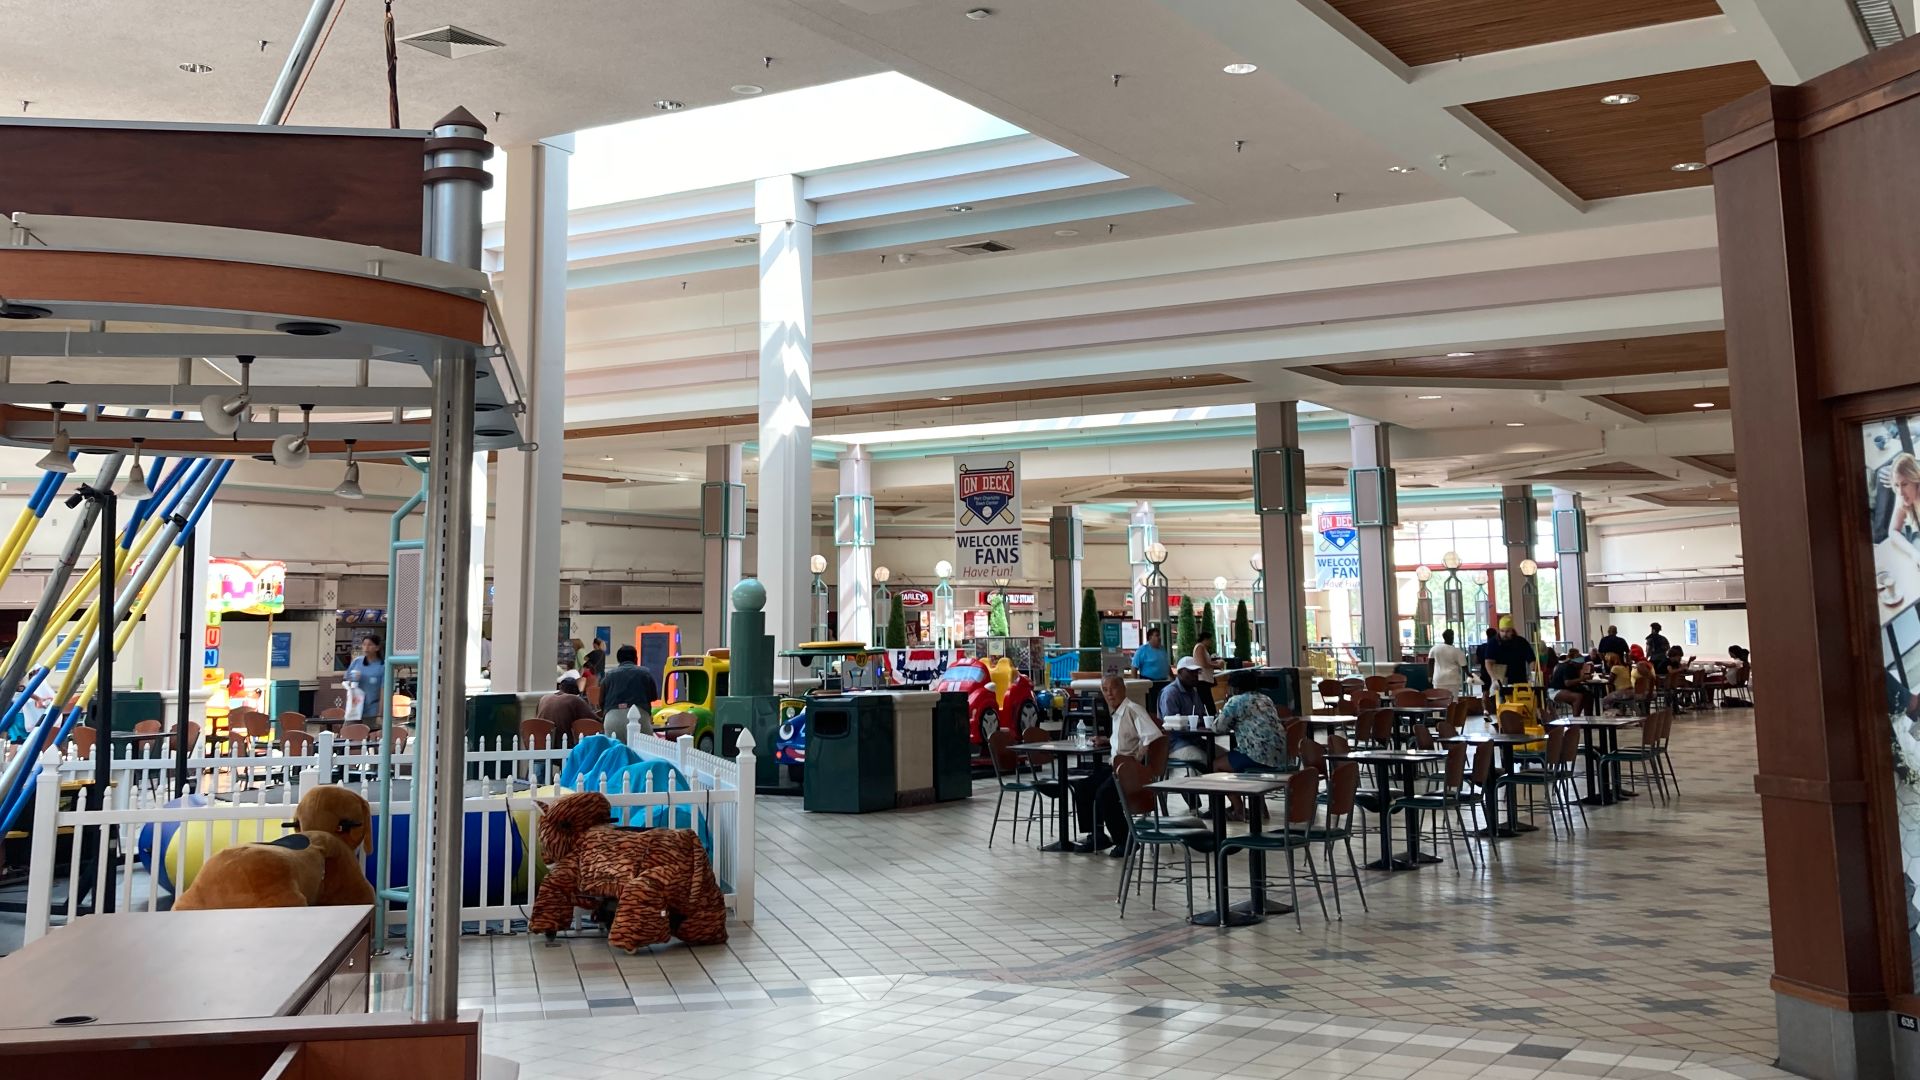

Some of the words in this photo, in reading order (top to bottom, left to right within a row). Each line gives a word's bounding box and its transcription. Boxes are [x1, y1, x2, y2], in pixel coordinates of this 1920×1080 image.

[963, 477, 977, 494] ON
[982, 475, 1010, 492] DECK
[1321, 516, 1332, 530] ON
[1336, 516, 1352, 528] DEC
[957, 534, 1019, 548] WELCOME
[975, 547, 1019, 564] FANS
[1317, 557, 1359, 567] WELCOM
[963, 566, 989, 577] Have
[991, 565, 1013, 577] Fun!
[1332, 567, 1358, 578] FAN
